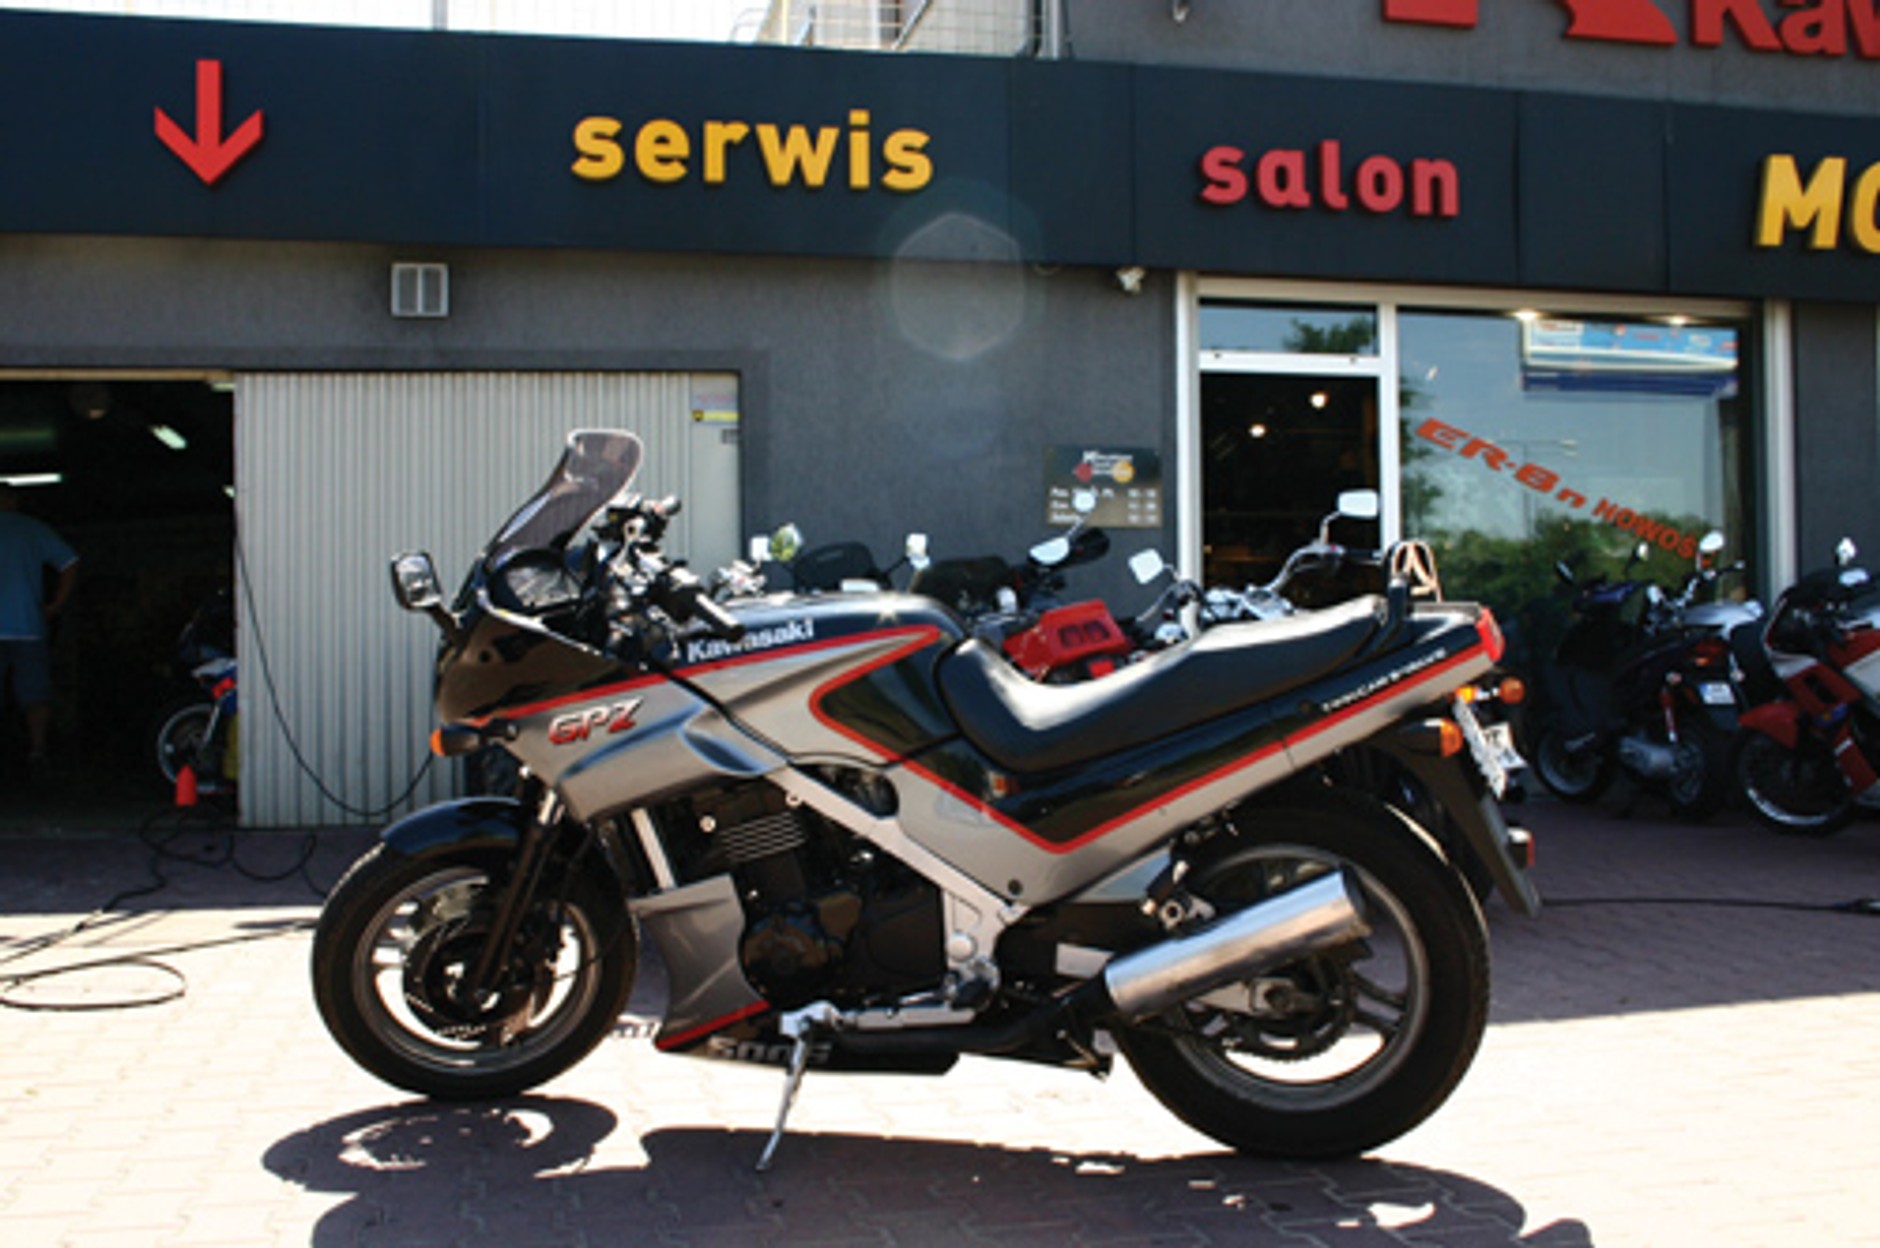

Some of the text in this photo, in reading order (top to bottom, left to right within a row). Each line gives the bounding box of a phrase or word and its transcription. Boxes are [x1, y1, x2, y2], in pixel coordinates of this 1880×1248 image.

[571, 109, 933, 191] serwis
[1200, 139, 1460, 216] salon
[687, 617, 814, 663] Kawasaki
[548, 696, 643, 745] GPZ
